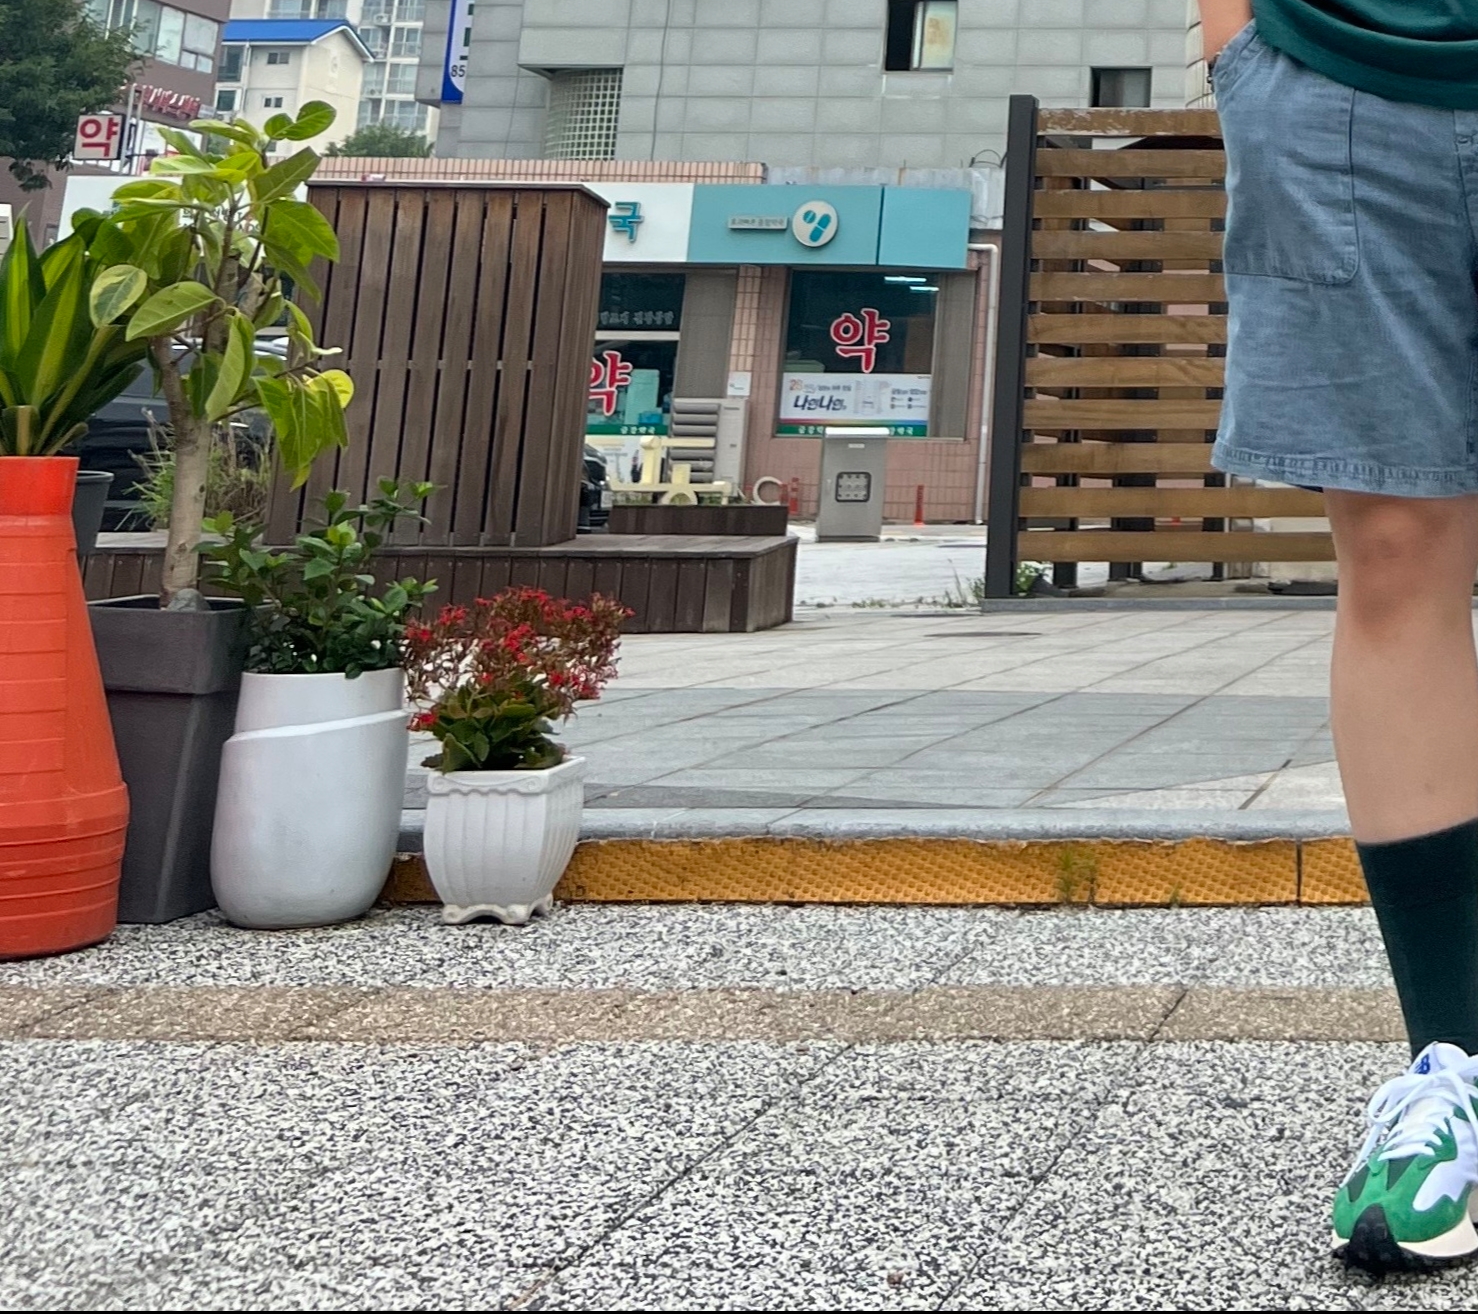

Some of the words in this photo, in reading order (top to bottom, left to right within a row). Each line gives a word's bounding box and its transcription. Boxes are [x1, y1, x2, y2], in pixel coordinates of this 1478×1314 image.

[79, 118, 119, 158] 약
[608, 201, 644, 243] 국
[830, 308, 891, 373] 약
[589, 350, 633, 417] 약
